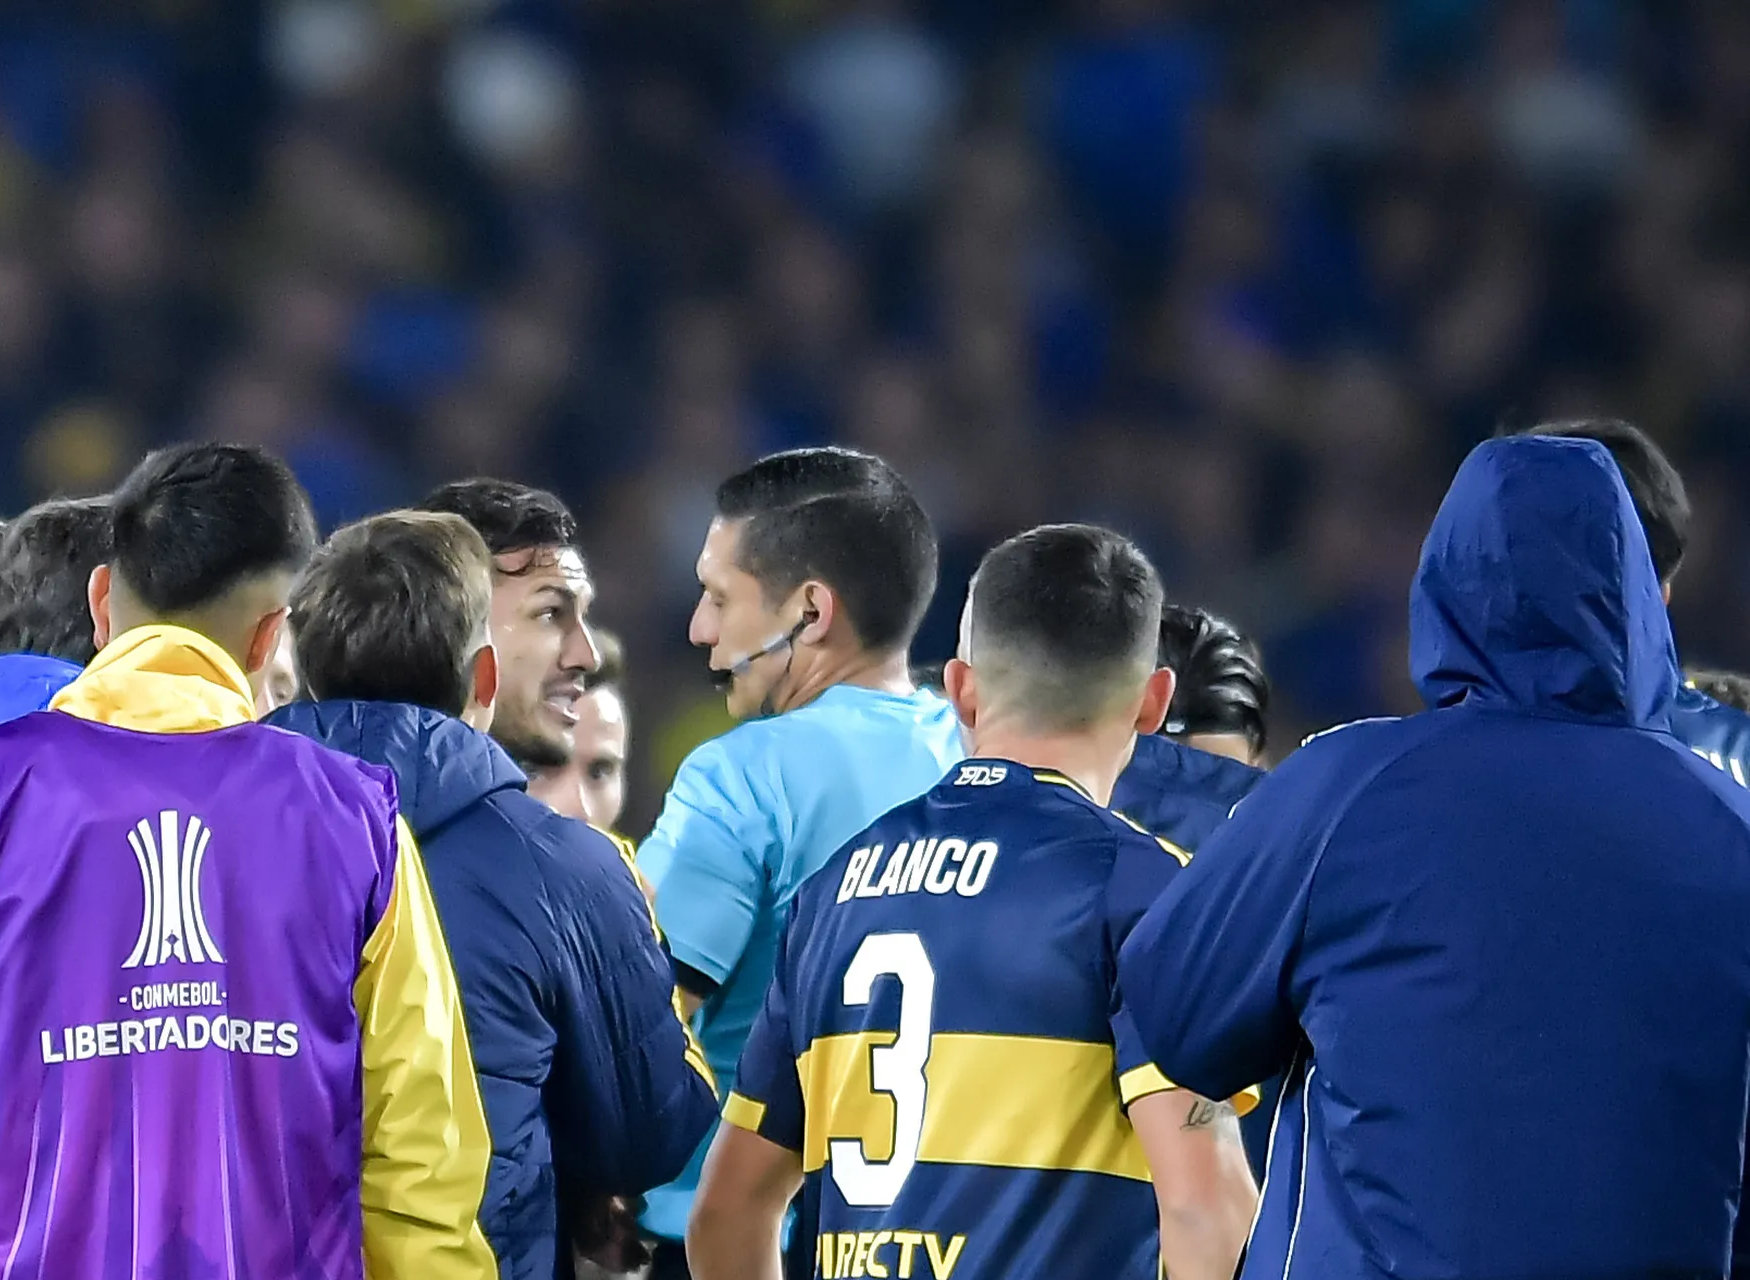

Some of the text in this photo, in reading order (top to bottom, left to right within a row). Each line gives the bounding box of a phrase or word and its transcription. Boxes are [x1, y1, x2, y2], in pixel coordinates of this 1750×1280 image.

[836, 838, 998, 905] BLANCO
[130, 981, 222, 1010] CONMEBOL
[40, 1014, 299, 1064] LIBERTADORES
[827, 932, 936, 1206] 3
